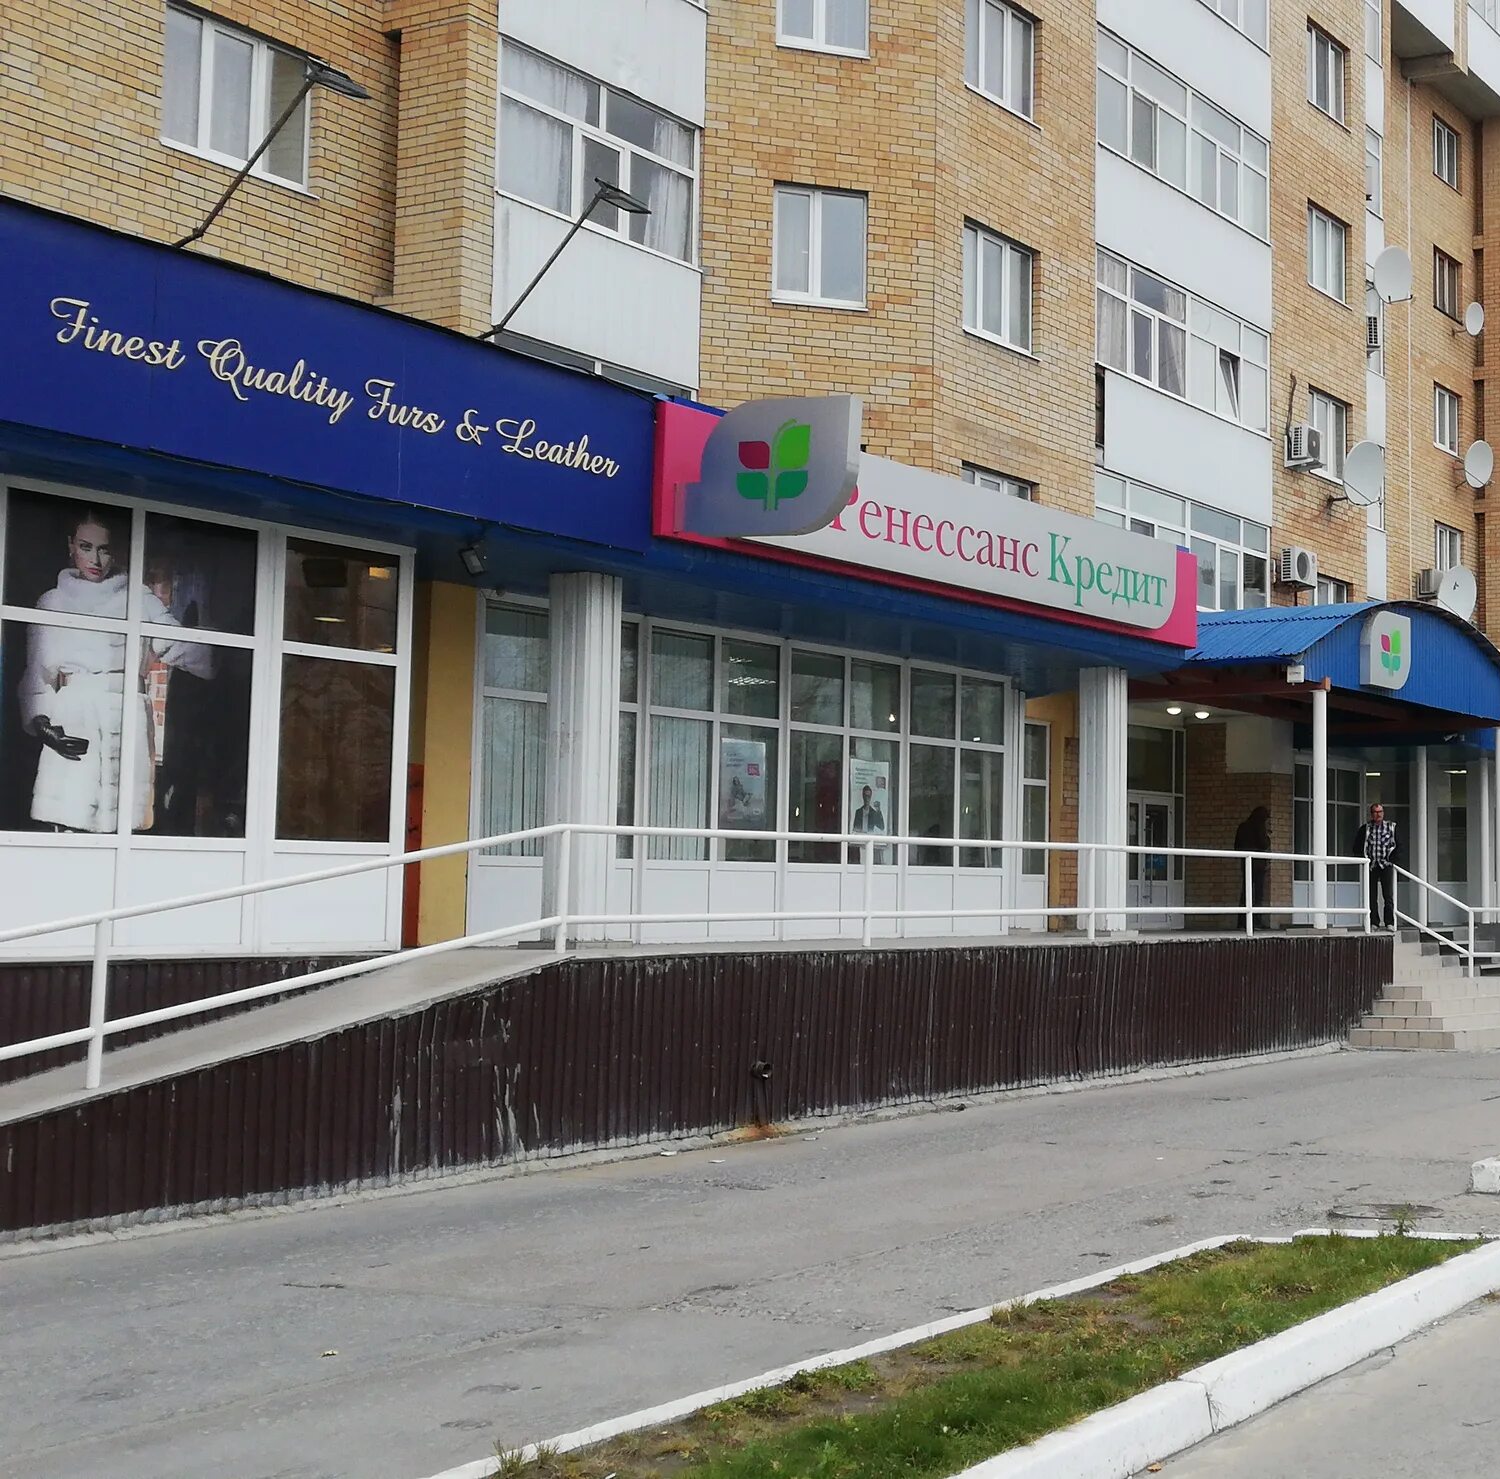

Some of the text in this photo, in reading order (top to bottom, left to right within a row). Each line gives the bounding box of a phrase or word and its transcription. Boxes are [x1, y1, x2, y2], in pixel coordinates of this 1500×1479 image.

[49, 296, 621, 479] Finest Quality Furs & Leather
[1047, 530, 1168, 609] Кредит
